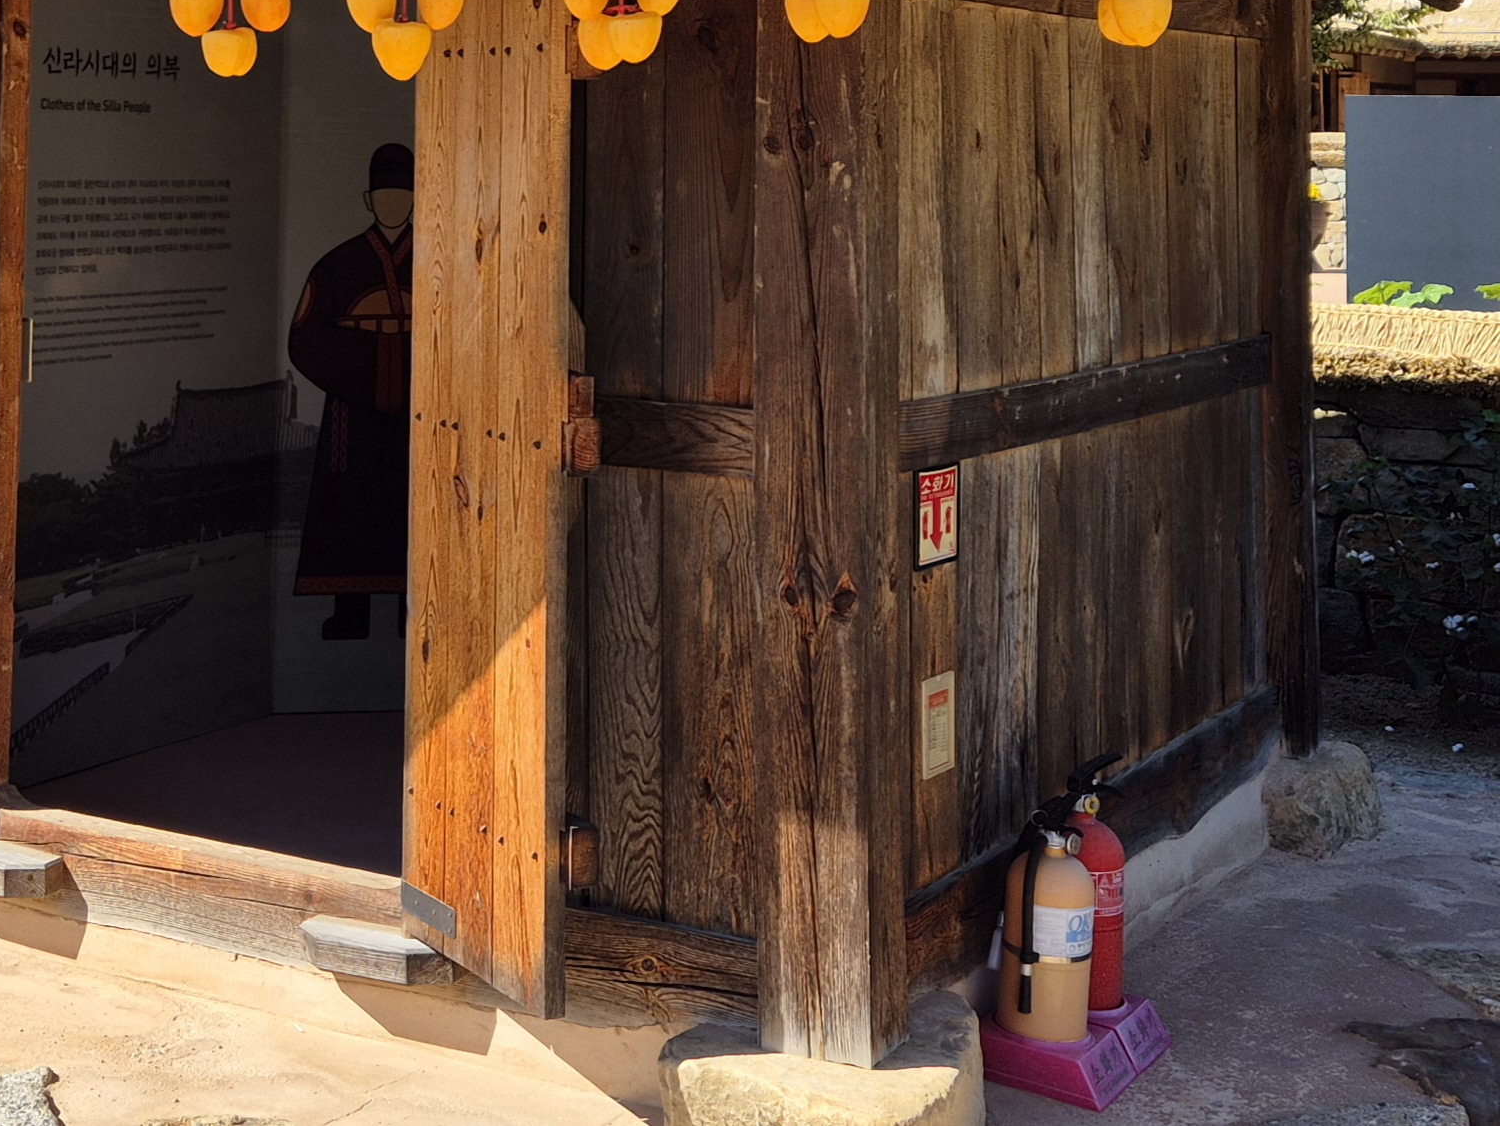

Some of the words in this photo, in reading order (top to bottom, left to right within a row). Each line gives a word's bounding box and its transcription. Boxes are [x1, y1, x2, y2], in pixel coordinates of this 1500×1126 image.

[42, 46, 137, 79] 신라시대의
[145, 53, 181, 81] 의복
[41, 98, 75, 111] Clothes
[77, 99, 87, 111] of
[87, 100, 102, 112] the
[103, 100, 122, 113] Silla
[124, 101, 152, 115] People
[921, 473, 954, 495] 소화기
